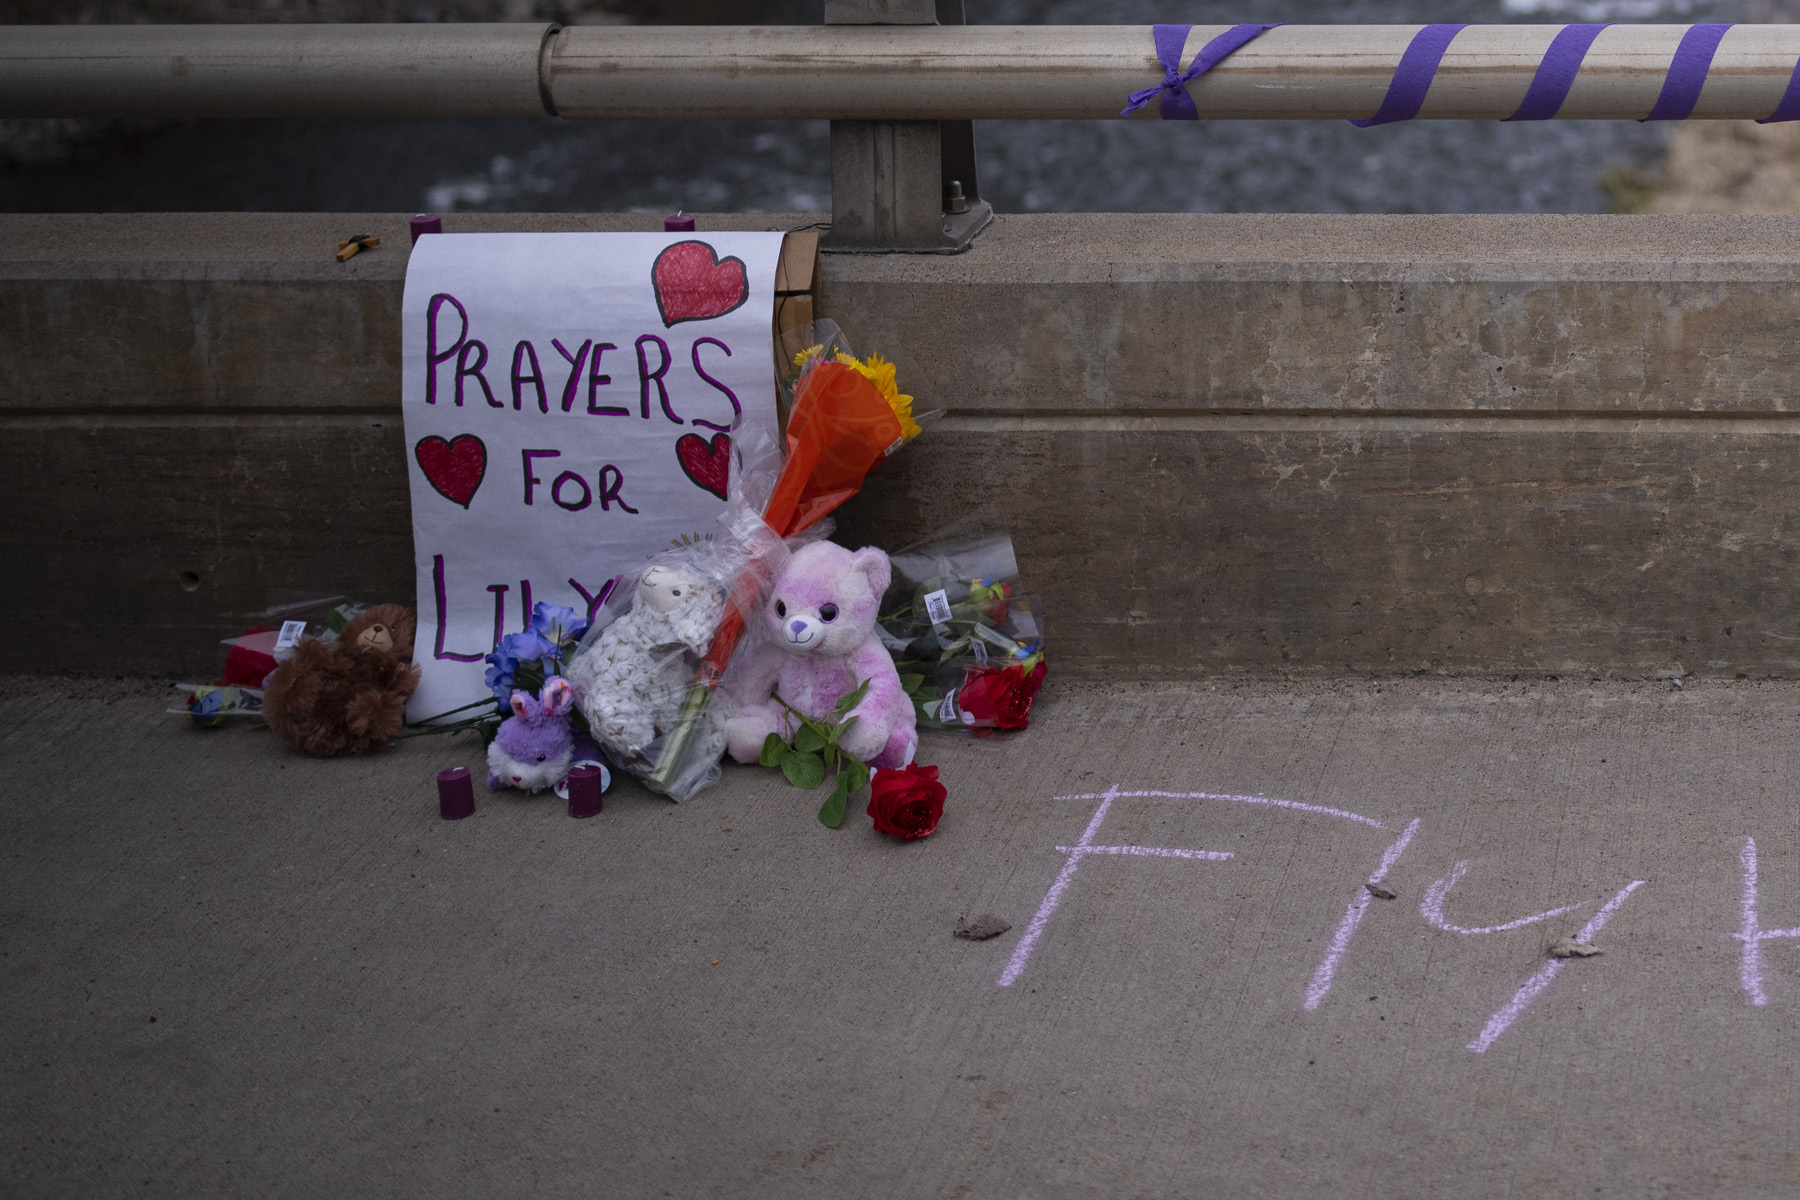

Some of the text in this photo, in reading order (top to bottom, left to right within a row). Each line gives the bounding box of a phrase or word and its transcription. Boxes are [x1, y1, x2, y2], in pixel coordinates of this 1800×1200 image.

[426, 293, 742, 432] PRAYERS
[522, 449, 638, 513] FOR
[1001, 785, 1644, 1053] Fly
